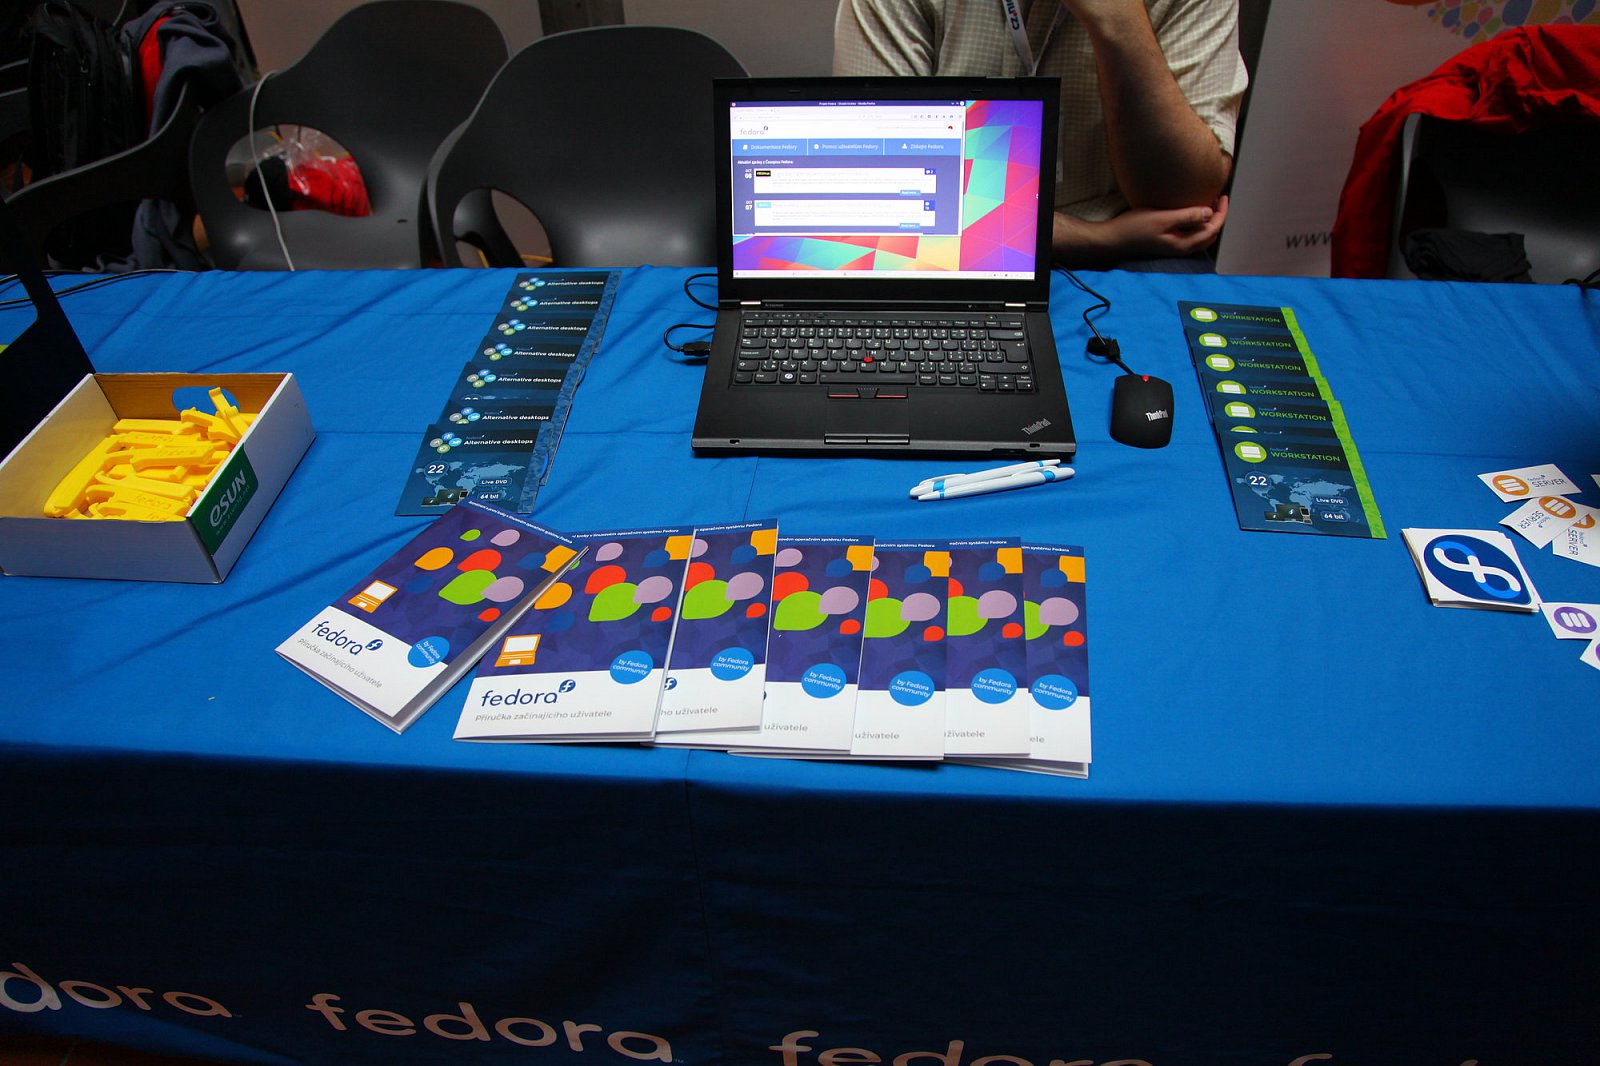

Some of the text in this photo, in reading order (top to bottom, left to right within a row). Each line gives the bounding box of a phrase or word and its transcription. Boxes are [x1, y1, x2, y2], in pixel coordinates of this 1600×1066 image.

[1221, 314, 1280, 323] WORKSTATION
[1230, 340, 1291, 348] WORKSTATION
[1238, 362, 1301, 371] WORKSTATION
[1249, 388, 1314, 397] WORKSTATION
[1145, 409, 1168, 421] ThinkPad
[1259, 411, 1326, 421] WORKSTATION
[1021, 418, 1052, 435] ThinkPad
[1270, 451, 1340, 462] WORKSTATION
[428, 464, 445, 474] 22
[1249, 475, 1267, 486] 22
[1532, 479, 1567, 488] SERVER
[1520, 510, 1544, 529] SERVER
[1568, 528, 1578, 555] SERVER
[312, 621, 363, 656] fedora
[627, 660, 648, 669] Fedora
[727, 657, 748, 665] Fedora
[612, 665, 648, 675] community
[713, 662, 750, 672] community
[804, 677, 842, 690] community
[819, 673, 841, 684] Fedora
[988, 678, 1011, 688] Fedora
[891, 685, 930, 697] community
[907, 681, 929, 691] Fedora
[973, 683, 1013, 695] community
[1048, 684, 1072, 695] Fedora
[481, 688, 558, 707] fedora
[1034, 688, 1073, 703] community
[305, 993, 673, 1063] fedora
